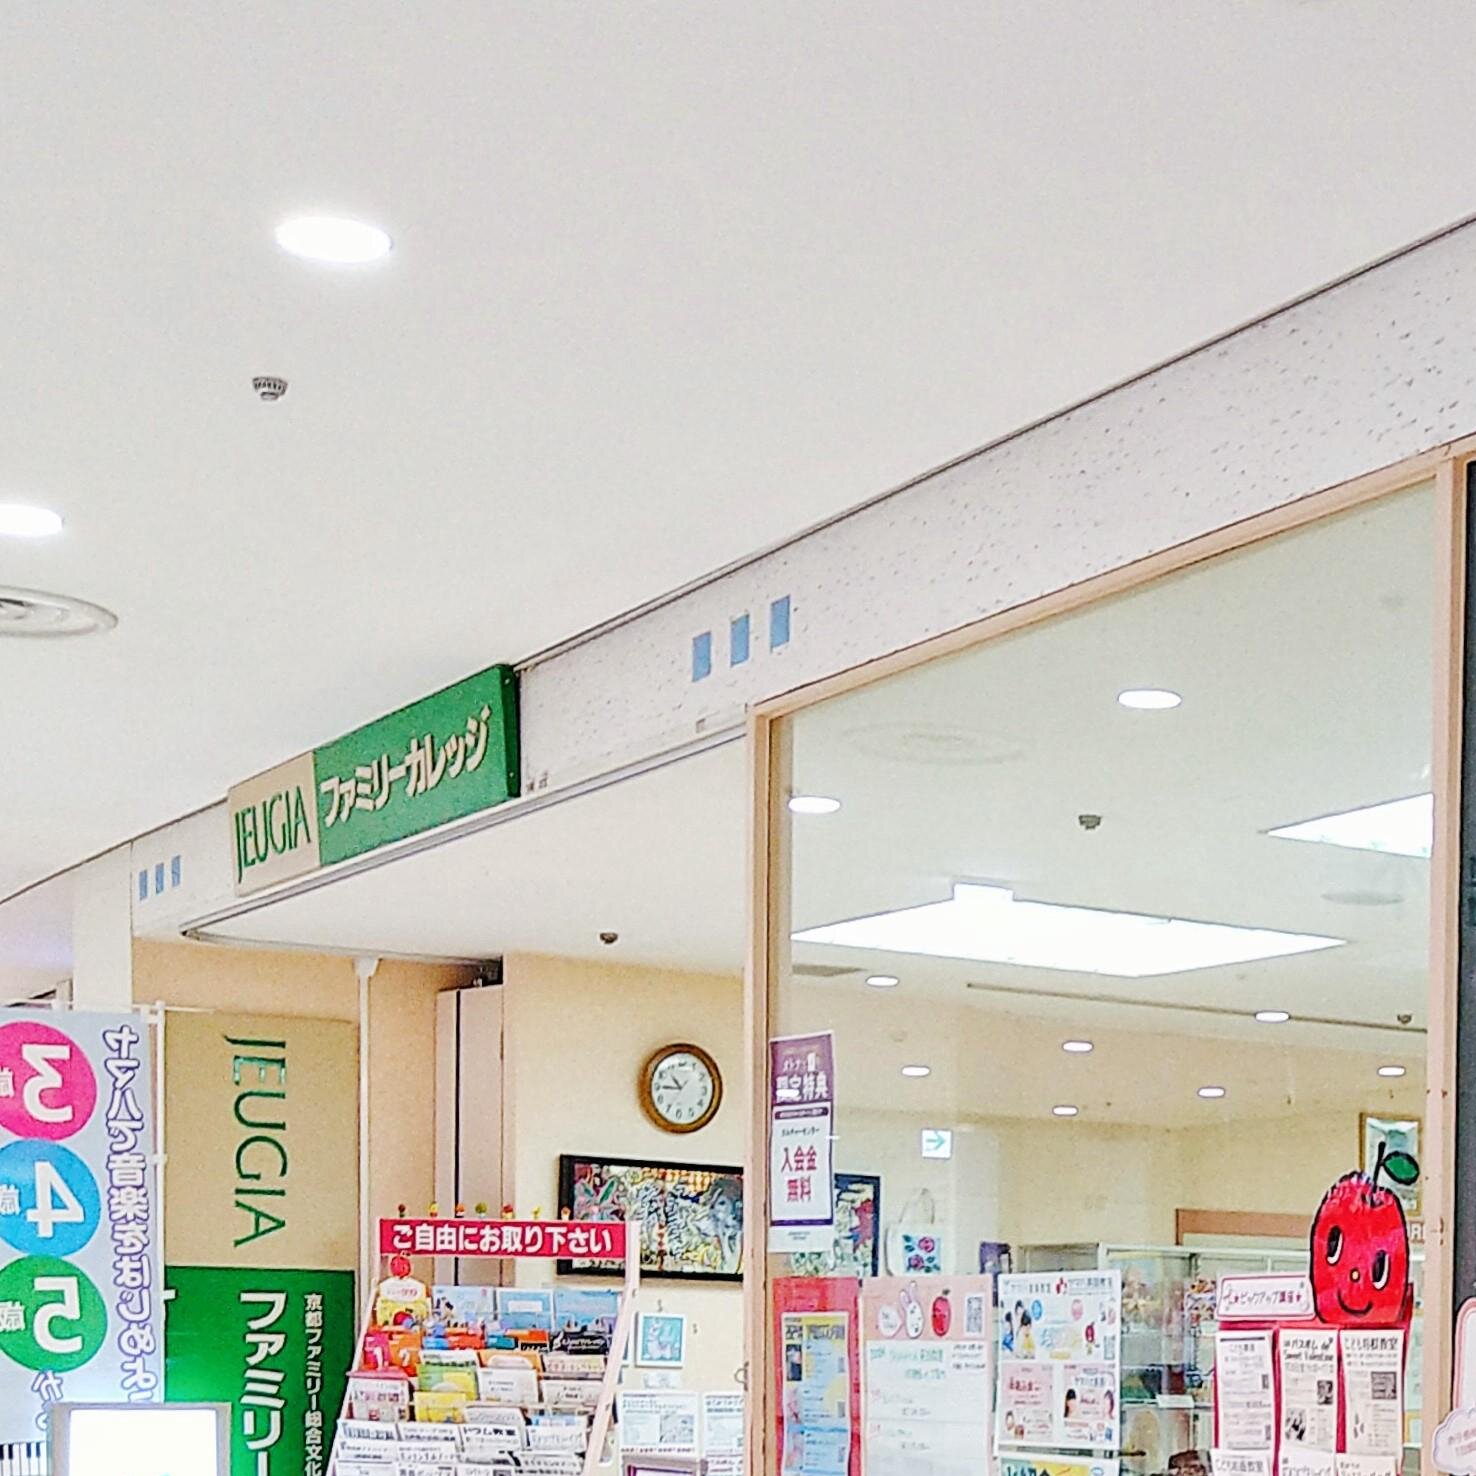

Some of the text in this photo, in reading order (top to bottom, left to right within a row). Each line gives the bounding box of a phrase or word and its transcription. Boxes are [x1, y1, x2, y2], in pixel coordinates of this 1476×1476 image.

[235, 703, 493, 882] JEUGIA ファミリーカレッジ
[224, 1034, 288, 1248] JEUGIA
[781, 1145, 818, 1173] 入会金
[392, 1223, 612, 1254] ご自由にお取り下さい
